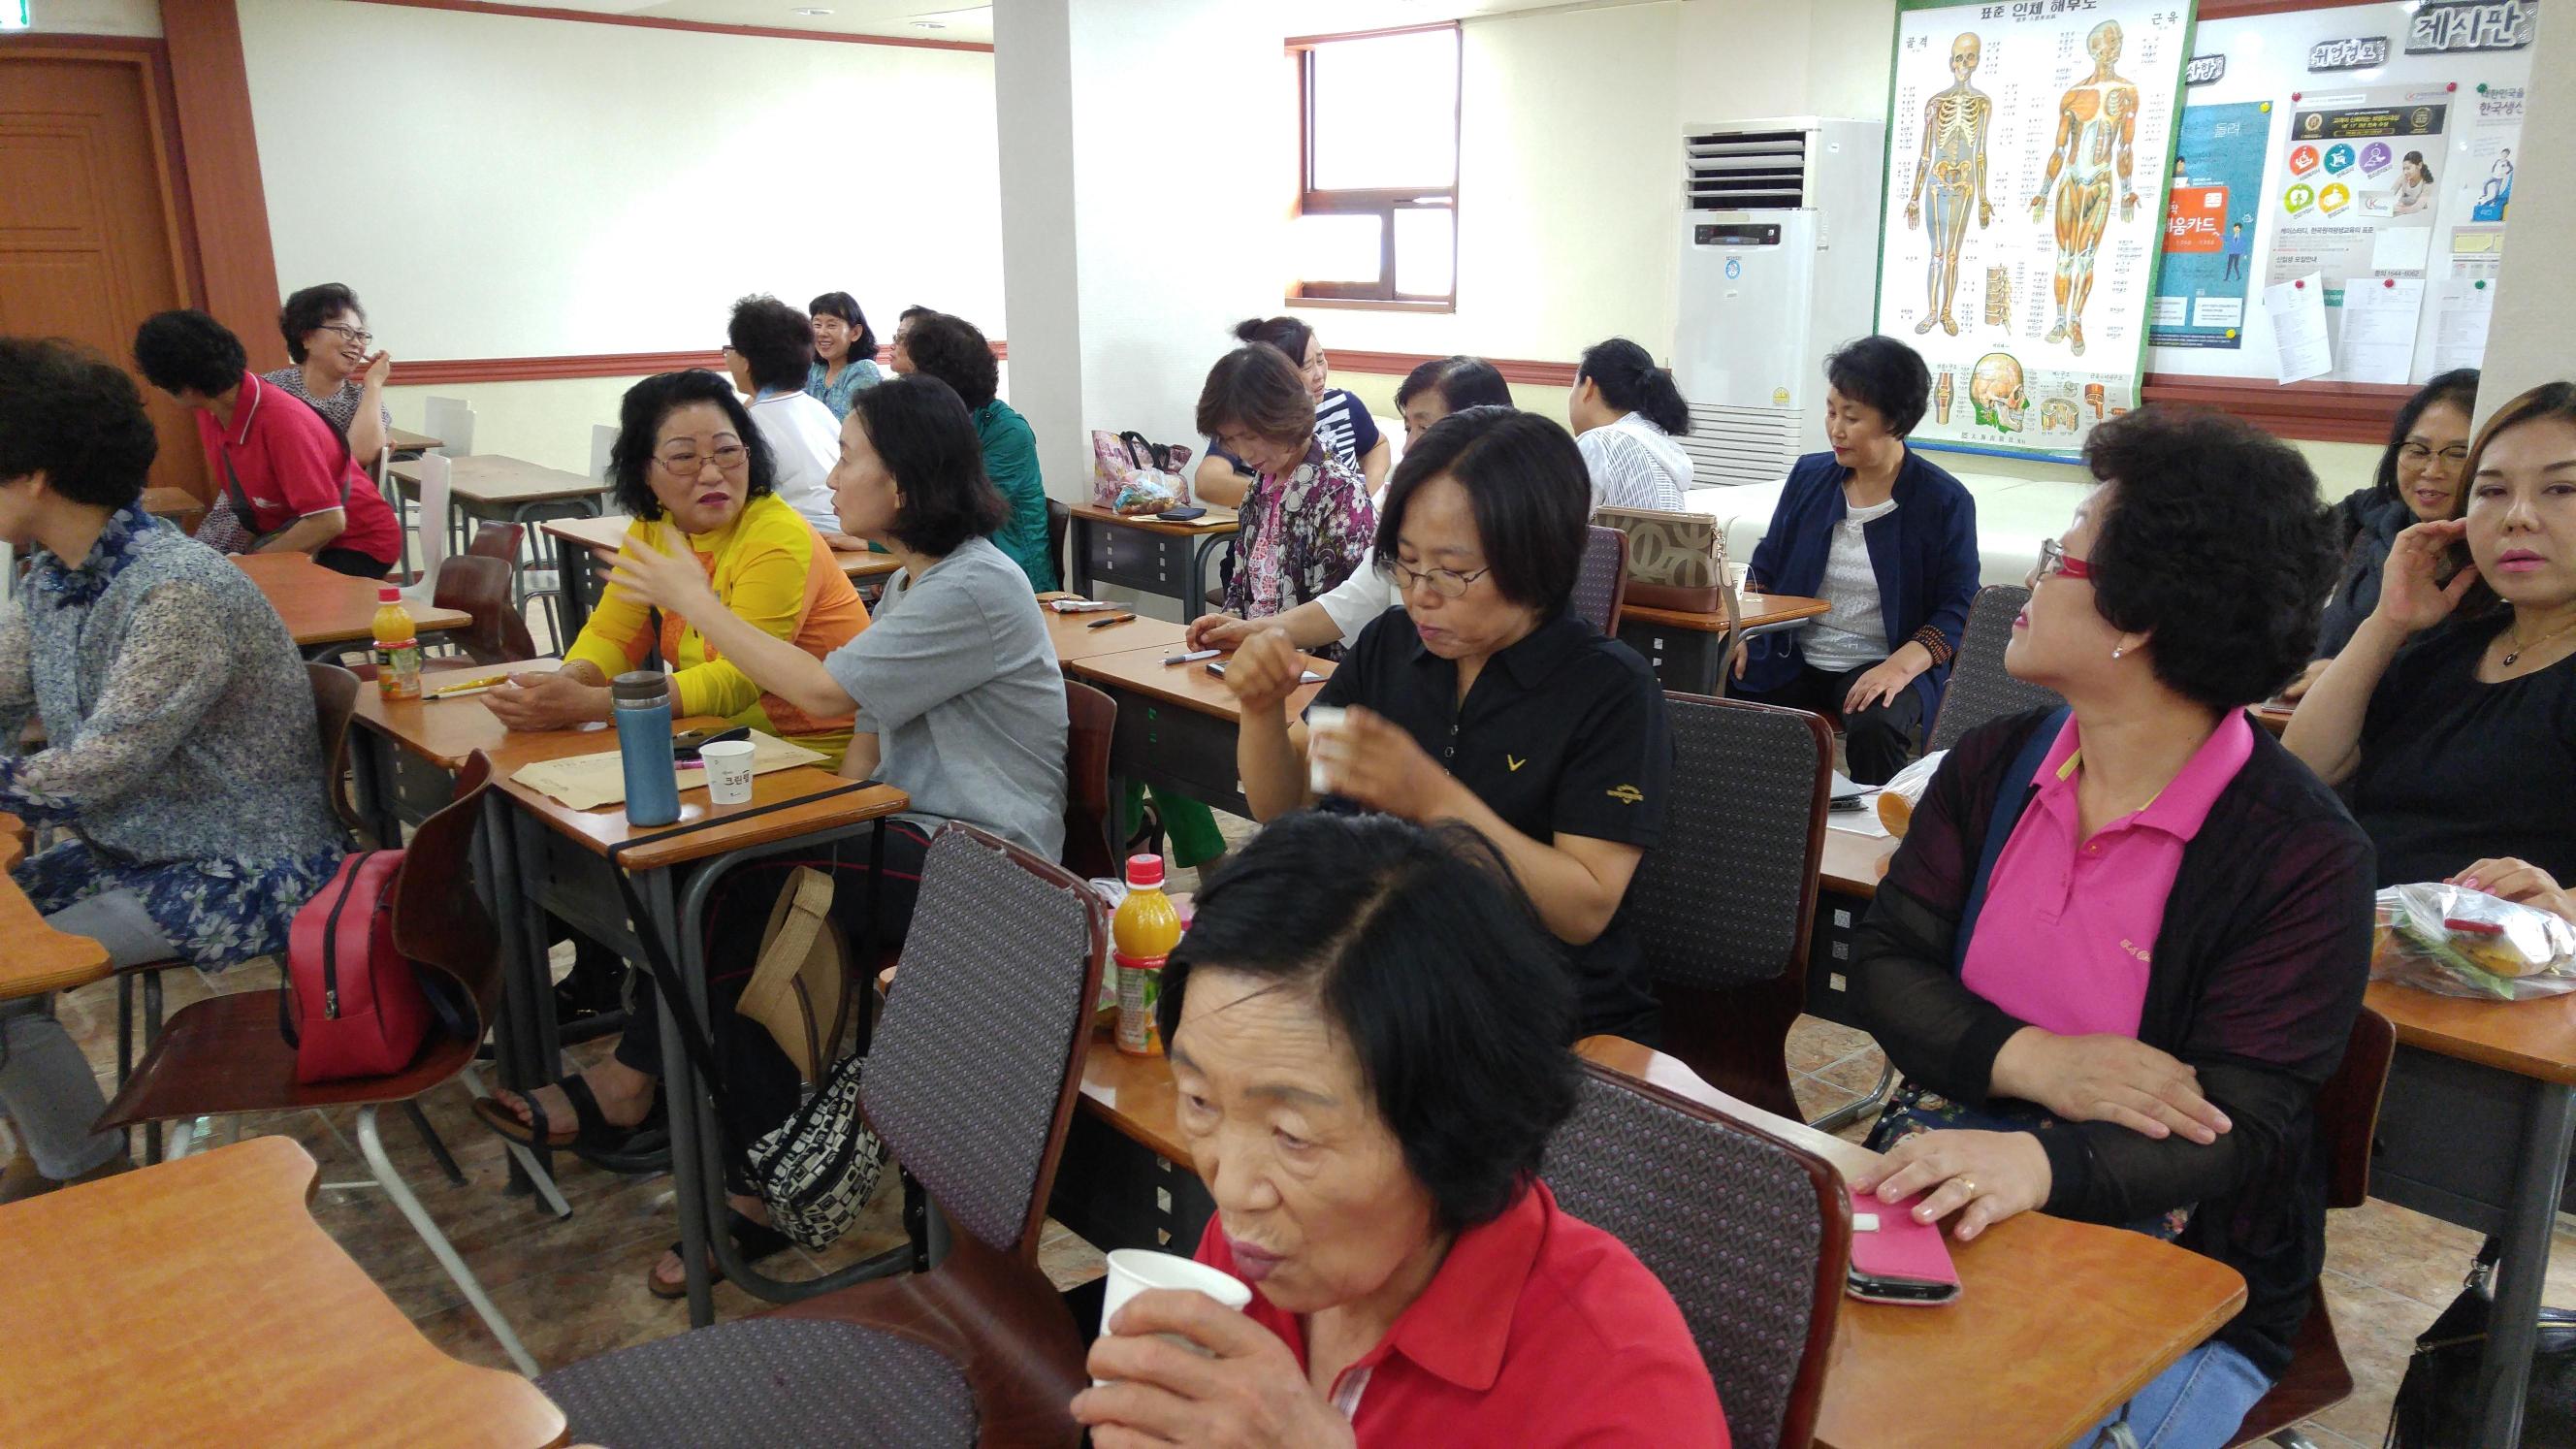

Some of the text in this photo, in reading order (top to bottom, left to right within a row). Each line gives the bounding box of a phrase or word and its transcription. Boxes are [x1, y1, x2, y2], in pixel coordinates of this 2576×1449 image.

[1981, 5, 2005, 19] 표준
[2012, 1, 2044, 17] 인체
[2416, 4, 2524, 47] 게시판
